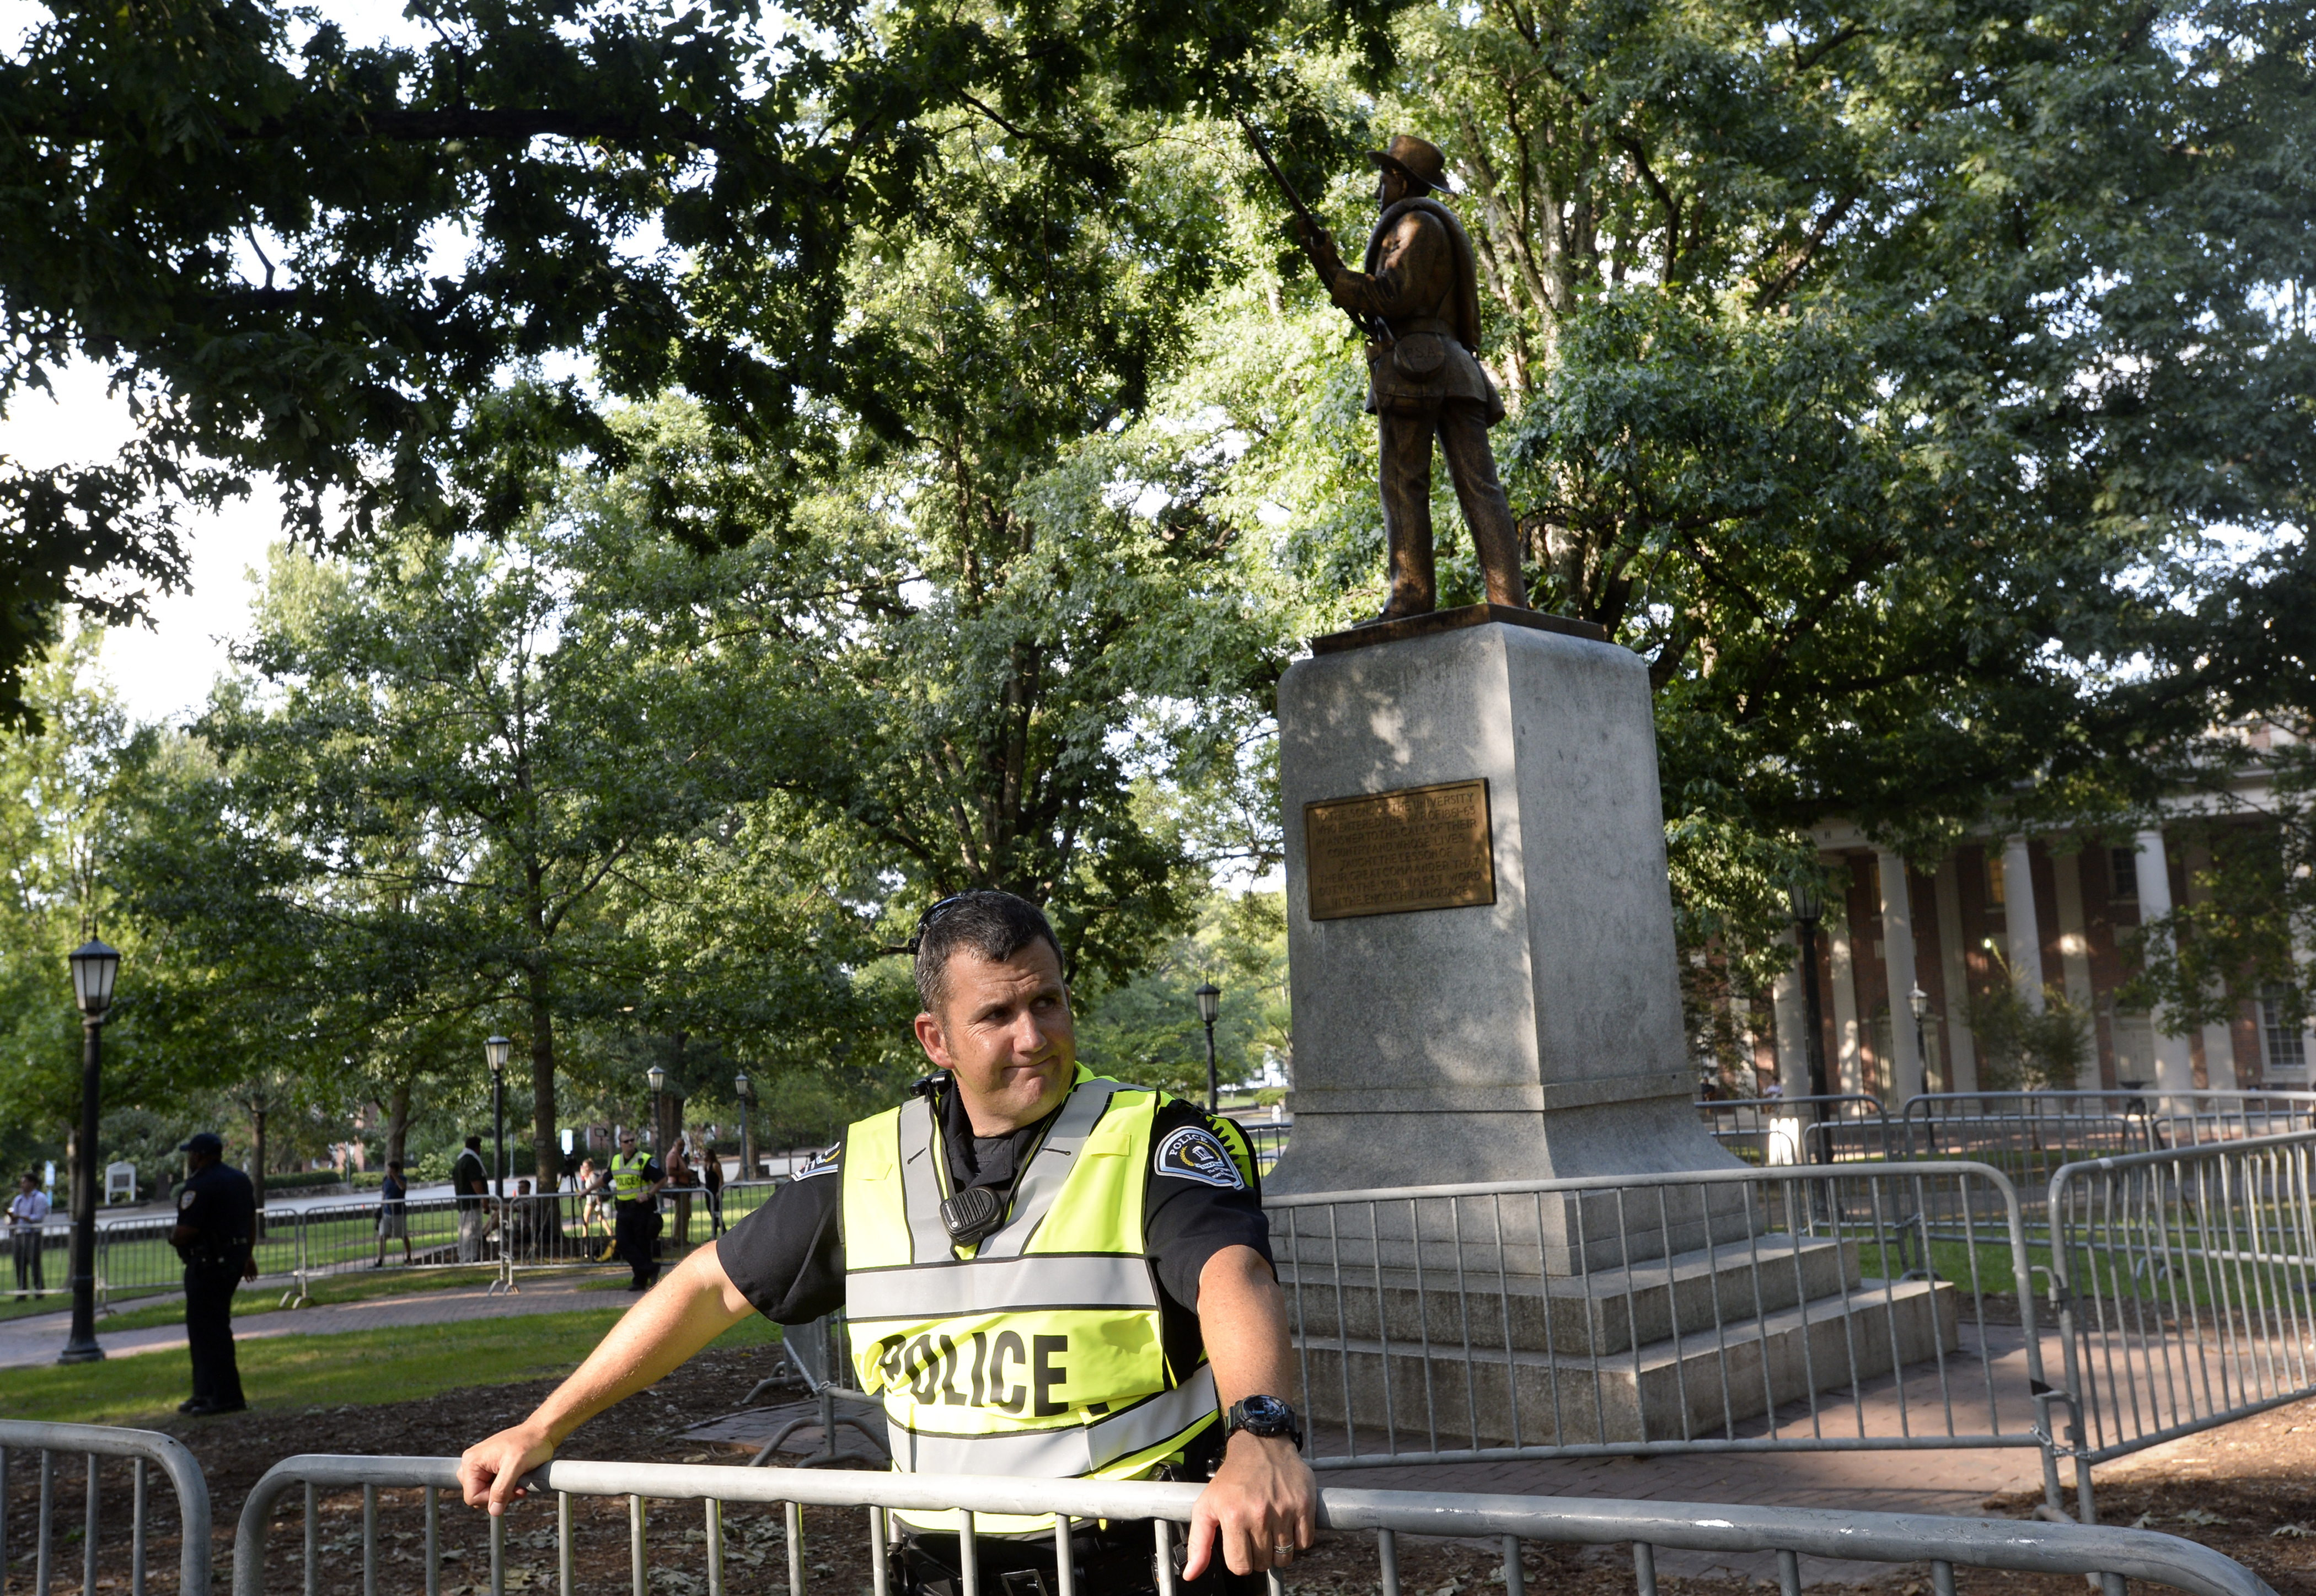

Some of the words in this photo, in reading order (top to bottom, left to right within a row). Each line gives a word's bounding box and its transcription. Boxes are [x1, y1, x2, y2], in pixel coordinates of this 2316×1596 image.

[1328, 810, 1346, 820] THE
[1350, 806, 1374, 817] SONS
[1376, 804, 1388, 814] OF
[1392, 801, 1411, 812] THE
[1413, 793, 1474, 808] UNIVERSITY
[1316, 824, 1336, 834] WHO
[1338, 819, 1381, 831] ENTERED
[1382, 815, 1403, 826] THE
[1407, 812, 1426, 823] WAR
[1428, 810, 1440, 820] OF
[1441, 806, 1476, 818] 1861-65
[1327, 833, 1364, 845] ANSWER
[1365, 831, 1378, 841] TO
[1379, 828, 1399, 839] THE
[1400, 824, 1428, 836] CALL
[1429, 823, 1443, 833] OF
[1444, 819, 1477, 830] THEIR
[1327, 845, 1370, 857] COUNTRY
[1371, 842, 1392, 852] AND
[1395, 838, 1430, 849] WHOSE
[1434, 834, 1465, 845] LIVES
[1341, 857, 1377, 867] TAUGHT
[1378, 854, 1397, 864] THE
[1399, 850, 1438, 861] LESSON
[1439, 848, 1452, 858] OF
[1318, 873, 1347, 883] THEIR
[1349, 869, 1381, 879] GREAT
[1382, 861, 1449, 876] COMMANDER
[1452, 857, 1480, 869] THAT
[1318, 885, 1344, 896] DUTY
[1347, 884, 1355, 893] IS
[1356, 882, 1376, 892] THE
[1380, 876, 1443, 889] SUBLIMEST
[1449, 872, 1482, 883] WORD
[1342, 895, 1361, 906] THE
[1364, 892, 1407, 903] ENGLISH
[1411, 886, 1468, 899] LANGUAGE
[1168, 1134, 1208, 1156] POLICE
[616, 1176, 635, 1186] POLICE
[878, 1330, 1069, 1417] POLICE
